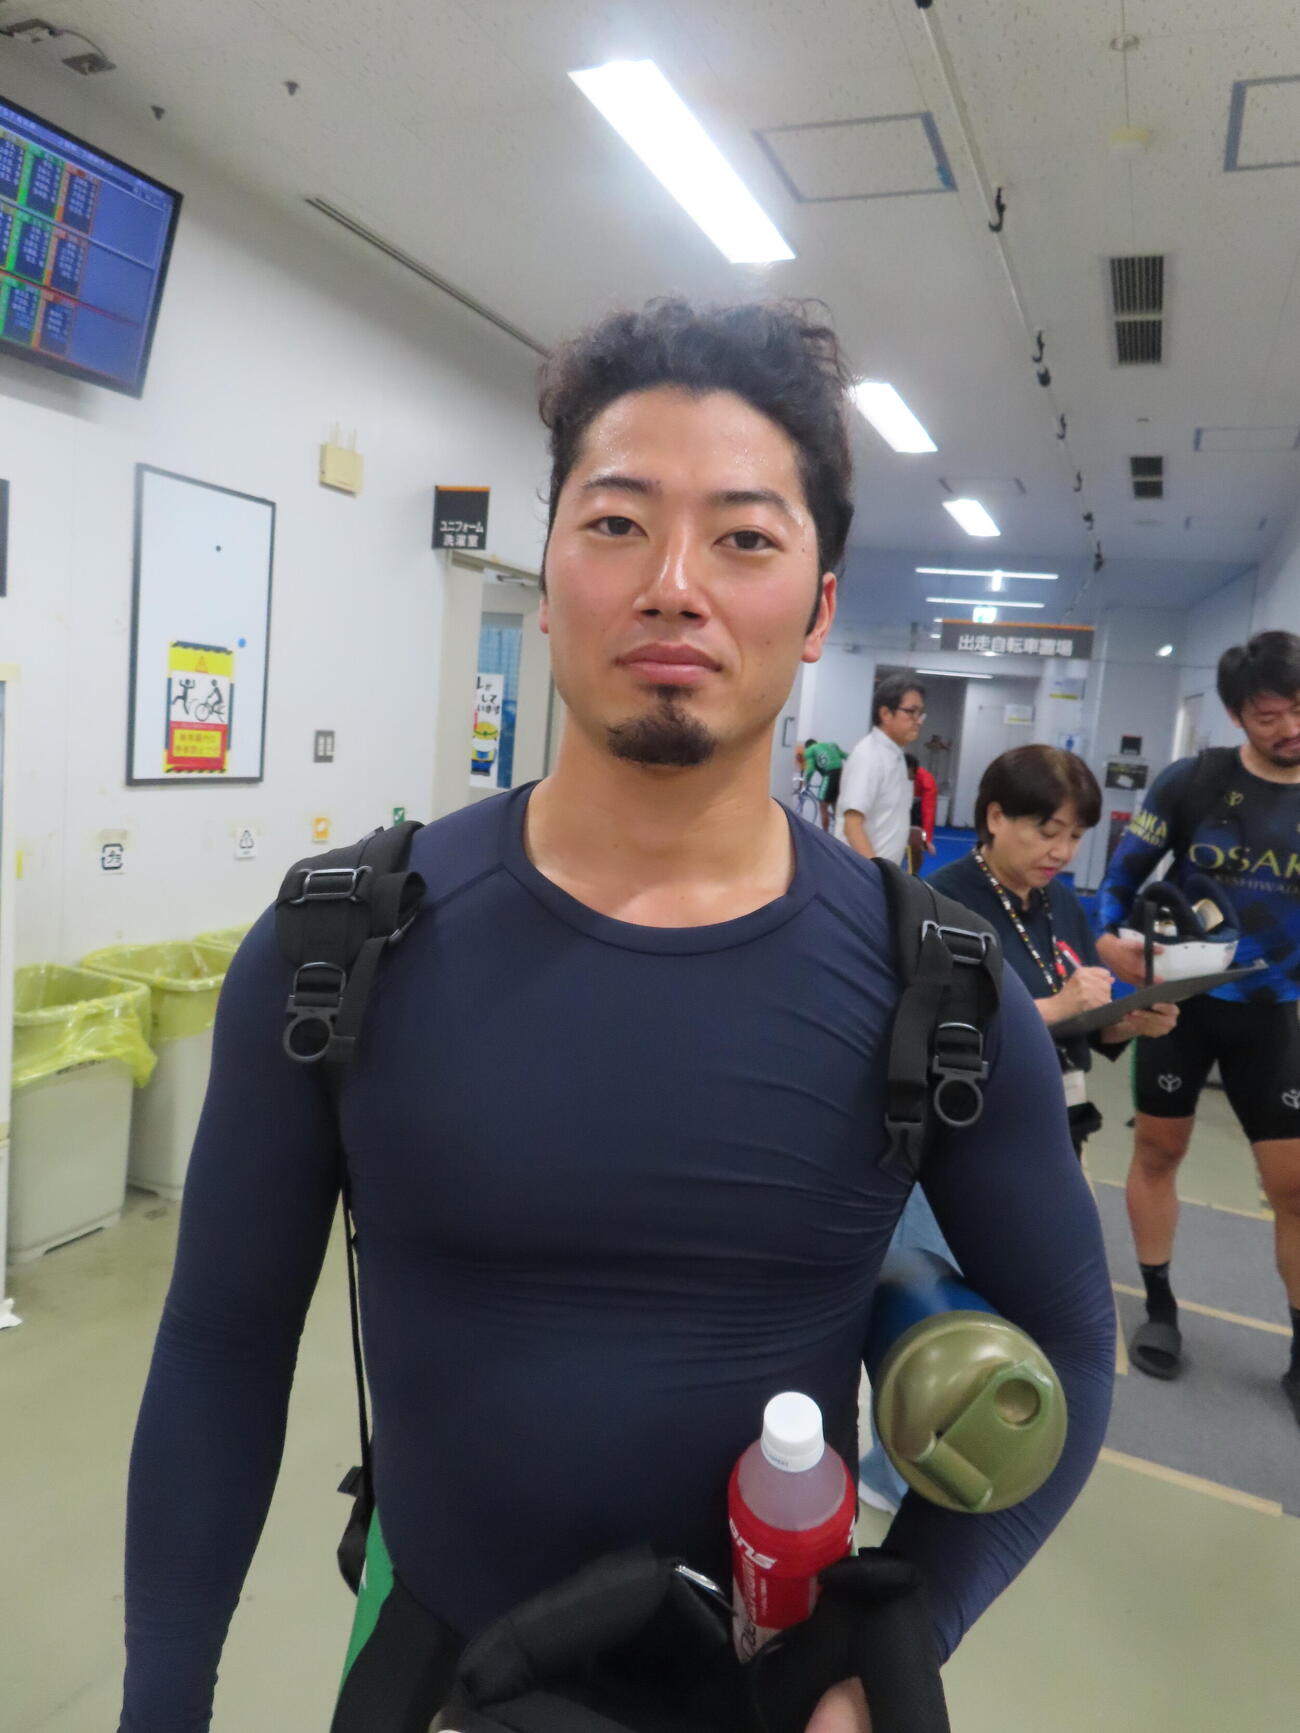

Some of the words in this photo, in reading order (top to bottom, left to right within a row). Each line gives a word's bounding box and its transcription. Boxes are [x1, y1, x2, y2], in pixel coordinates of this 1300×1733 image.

[440, 520, 484, 533] ユニフォーム
[957, 633, 1073, 657] 出走自転車置場
